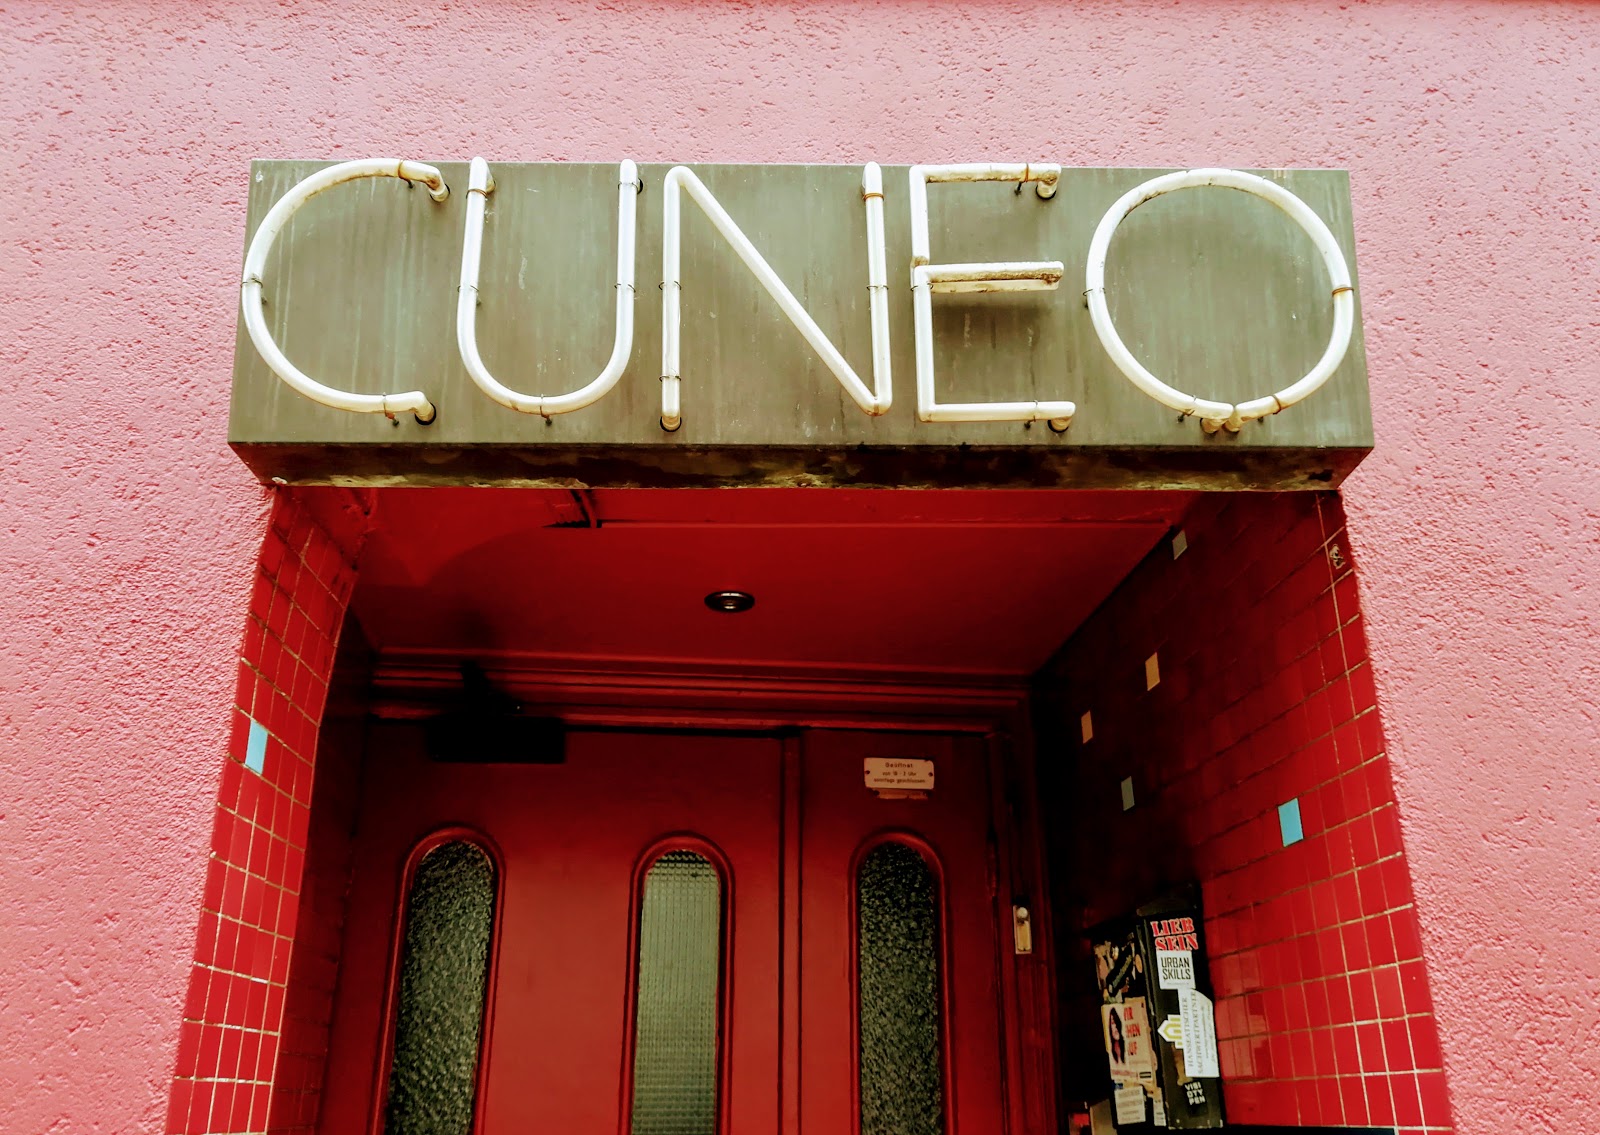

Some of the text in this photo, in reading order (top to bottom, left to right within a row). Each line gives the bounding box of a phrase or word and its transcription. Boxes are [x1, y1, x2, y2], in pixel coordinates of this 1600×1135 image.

[241, 156, 1355, 432] CUNEO
[1150, 917, 1195, 937] LIEB
[1155, 933, 1199, 951] SEIN
[1161, 957, 1190, 968] URBAN
[1162, 969, 1192, 980] SKILLS
